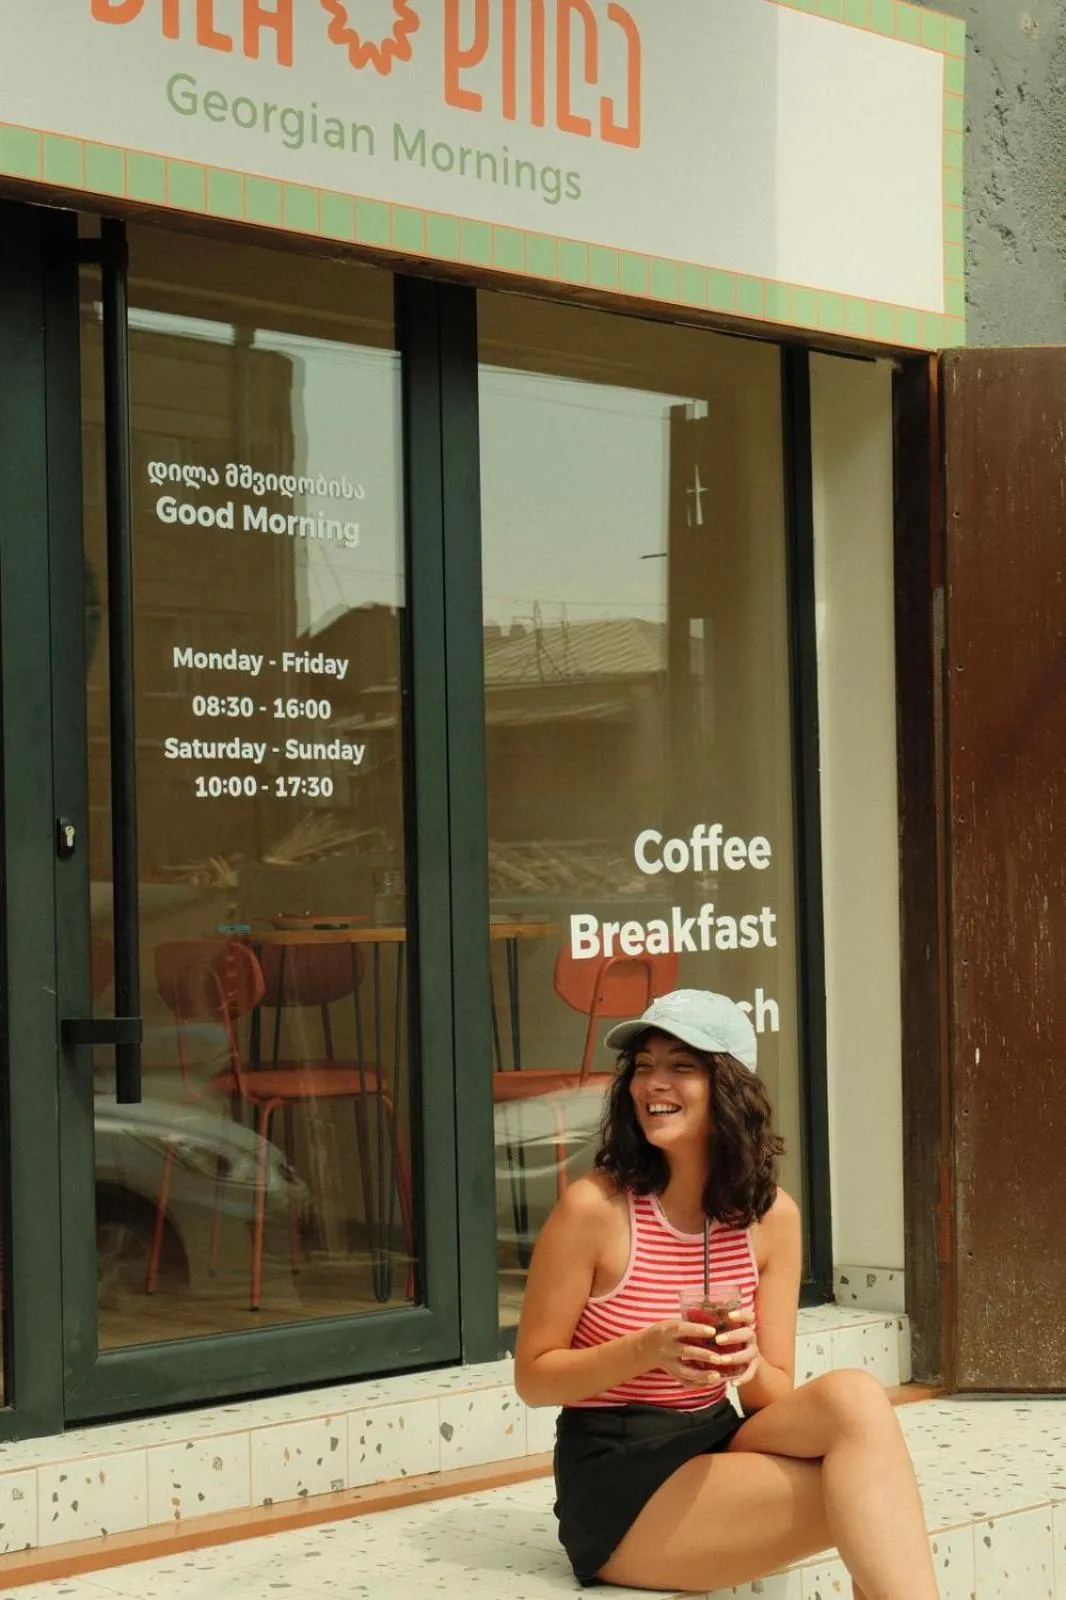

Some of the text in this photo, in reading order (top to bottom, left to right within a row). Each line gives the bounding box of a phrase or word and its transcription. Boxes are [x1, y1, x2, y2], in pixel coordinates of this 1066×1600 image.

[166, 72, 582, 205] Georgian Mornings
[147, 461, 365, 500] დილა მშვიდობისა
[156, 496, 360, 548] Good Morning
[173, 647, 264, 676] Monday
[282, 652, 349, 680] Friday
[192, 696, 254, 718] 08:30
[273, 698, 332, 720] 16:00
[164, 737, 267, 764] Saturday
[285, 739, 366, 766] Sunday
[195, 775, 257, 798] 10:00
[275, 776, 334, 798] 17:30
[634, 823, 772, 875] Coffee
[570, 902, 778, 960] Breakfast
